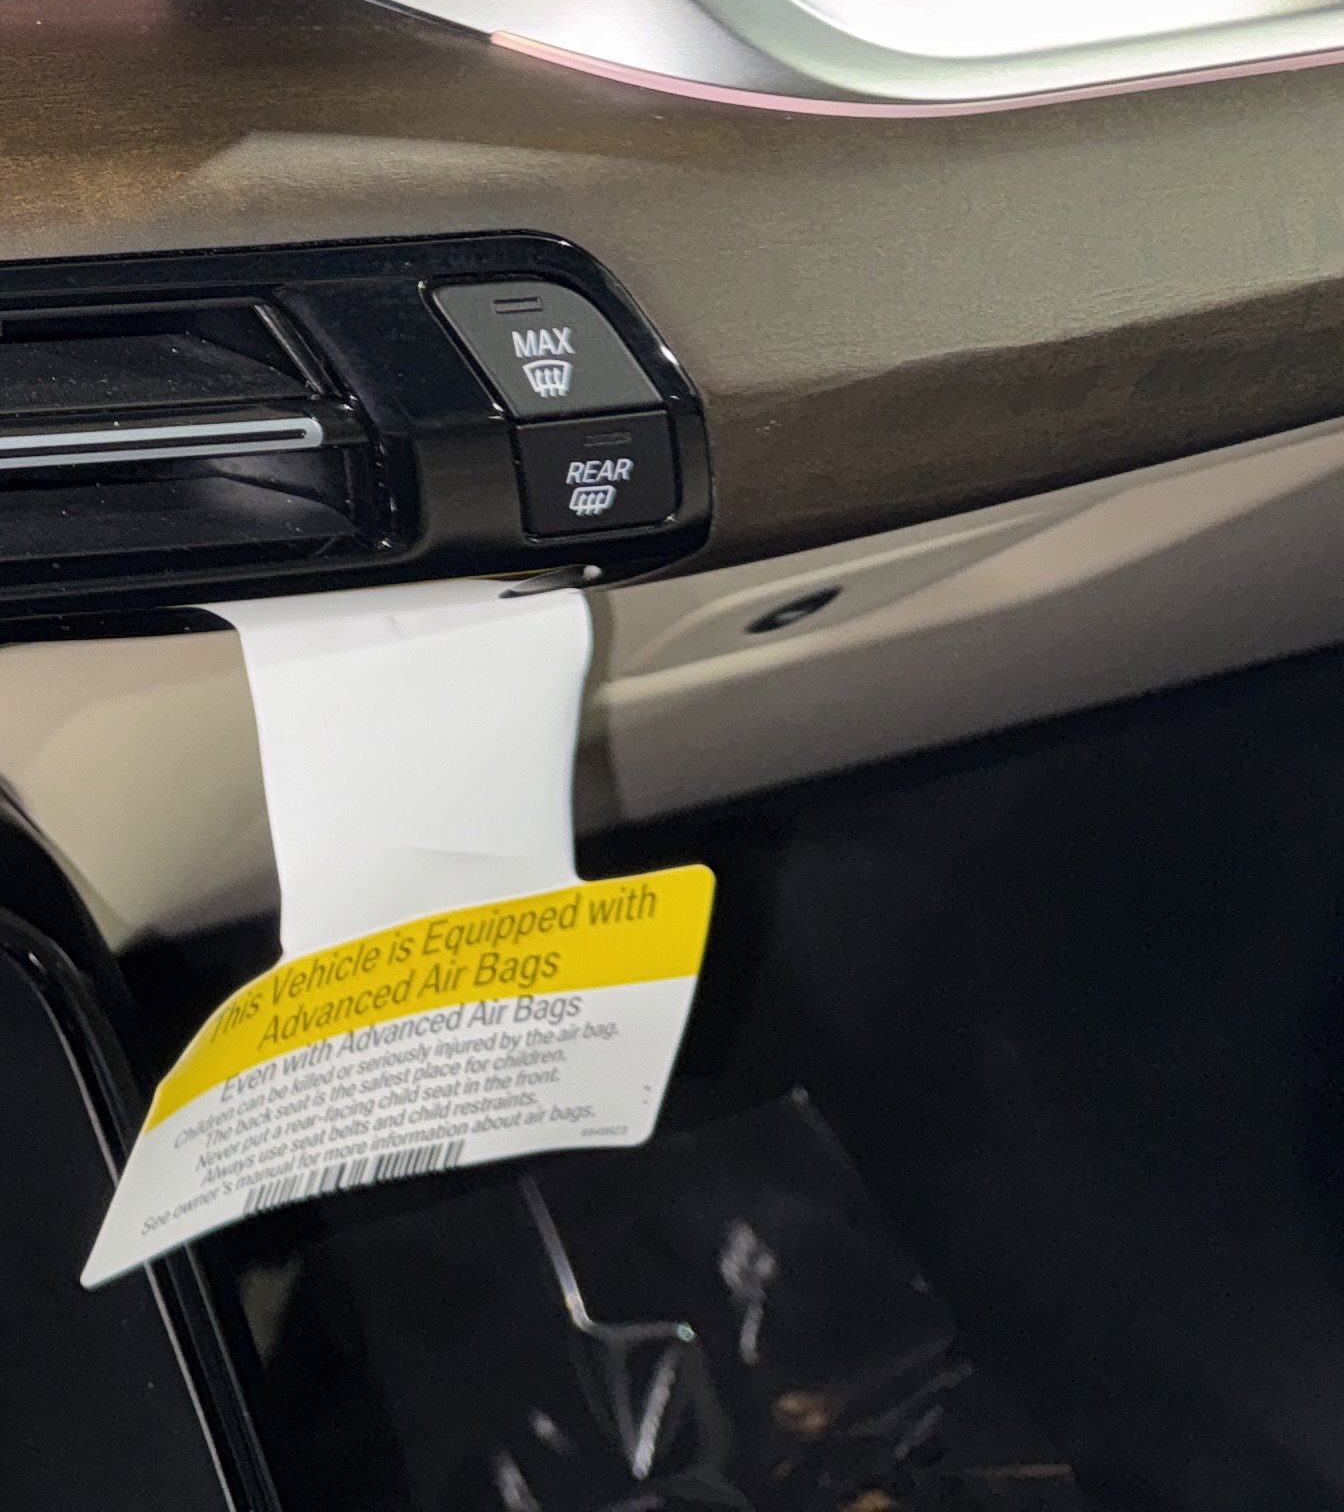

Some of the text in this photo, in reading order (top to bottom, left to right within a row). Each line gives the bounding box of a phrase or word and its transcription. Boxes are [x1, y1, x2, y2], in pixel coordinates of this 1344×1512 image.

[511, 326, 576, 359] MAX
[565, 458, 634, 485] REAR
[211, 884, 657, 1045] This Vehicle is Equipped with
[256, 949, 563, 1052] Advanced Air Bags
[174, 1021, 619, 1149] Children can be killed or seriously injured by the air bag.
[206, 1048, 567, 1149] The back seat is the safest place for children.
[221, 995, 583, 1103] Even with Advanced Air Bags
[141, 1208, 171, 1236] See
[235, 1157, 297, 1191] manual
[297, 1150, 321, 1169] for
[323, 1140, 369, 1163] more
[369, 1120, 468, 1152] information
[471, 1111, 522, 1133] about
[524, 1107, 545, 1125] air
[549, 1103, 595, 1123] bags.
[196, 1066, 560, 1172] Never put a rear-facing child seat in the front.
[201, 1090, 539, 1187] Always use seat belts and child restraints.
